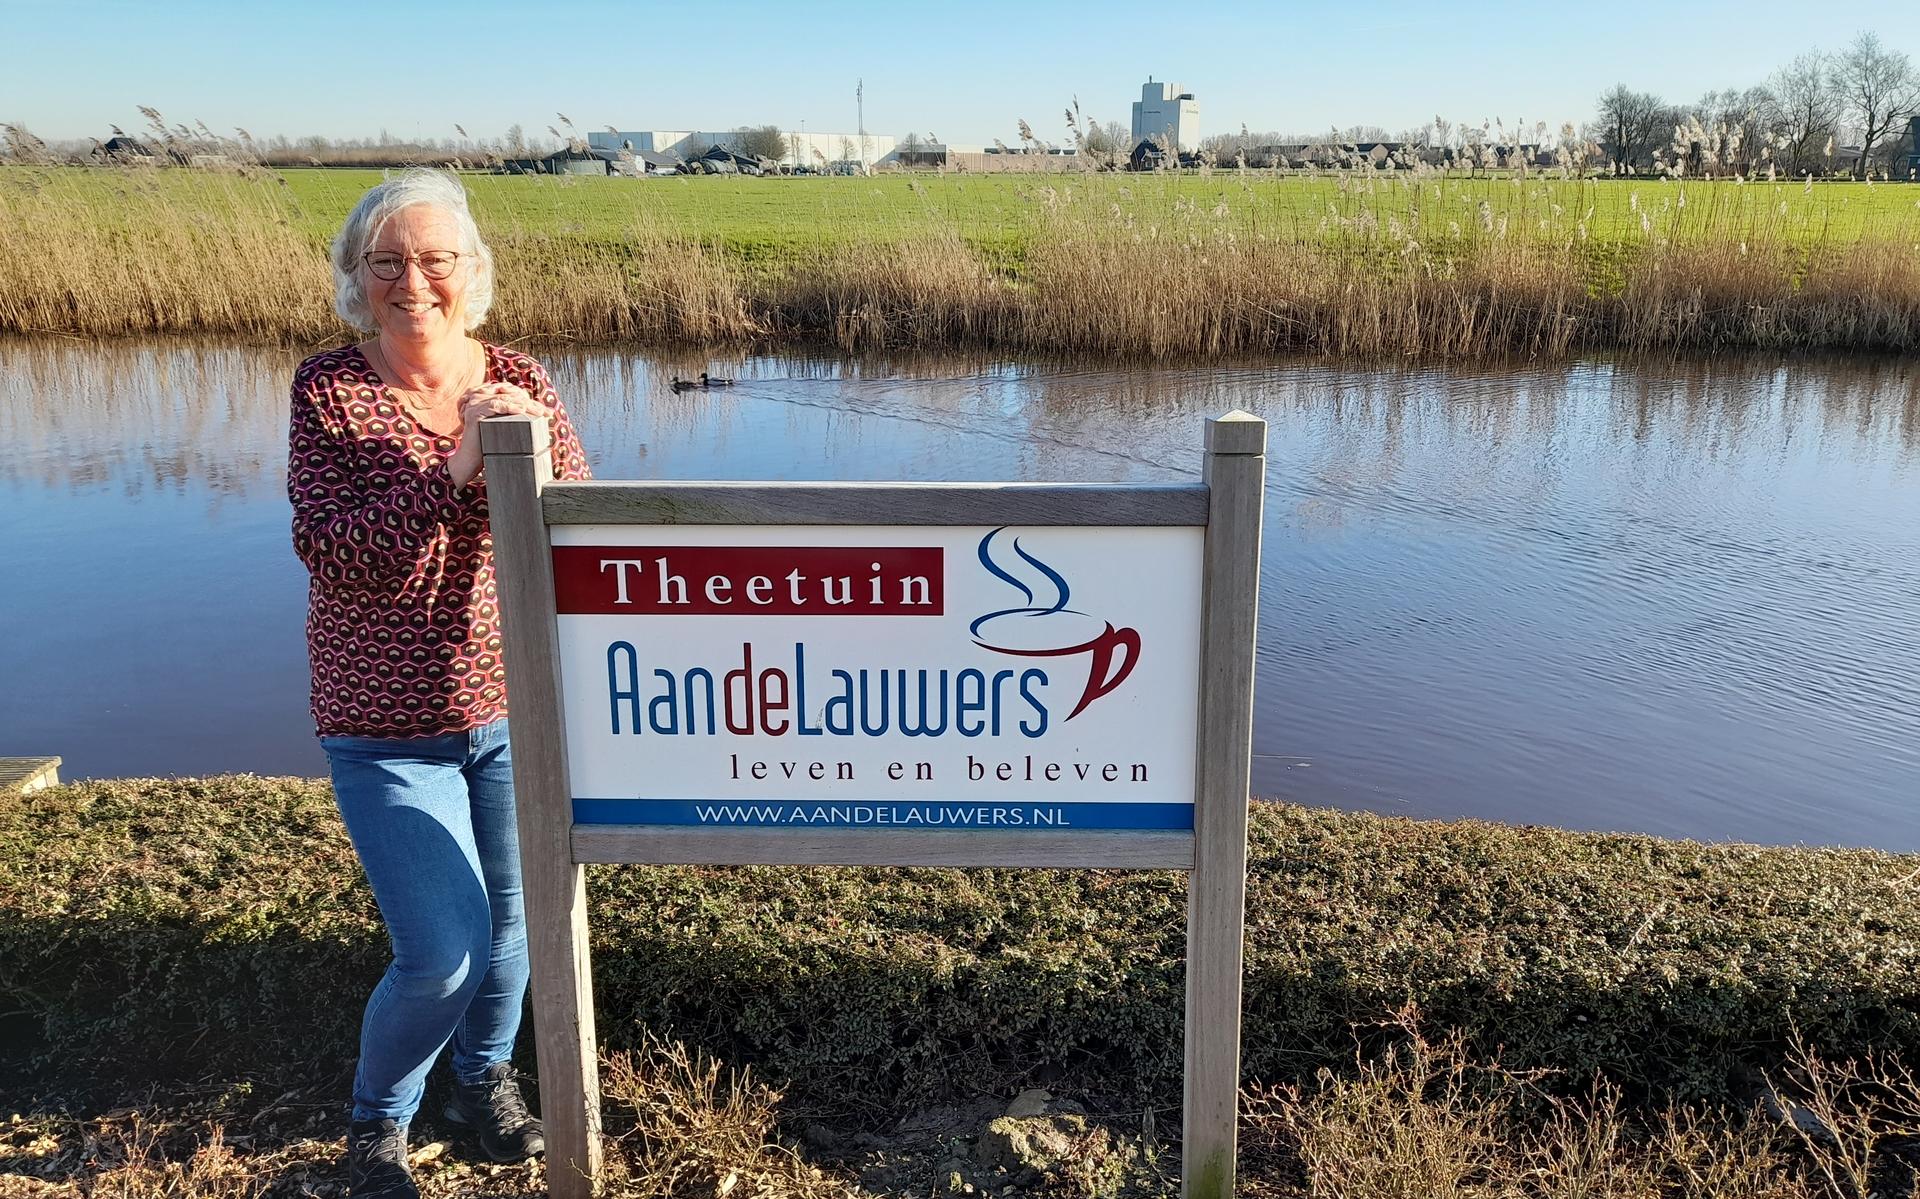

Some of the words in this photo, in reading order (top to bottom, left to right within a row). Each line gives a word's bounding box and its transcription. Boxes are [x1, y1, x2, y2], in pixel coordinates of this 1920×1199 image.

[600, 558, 933, 607] Theetuin
[730, 754, 856, 781] leven
[886, 763, 935, 782] en
[967, 755, 1149, 783] beleven
[695, 804, 1071, 827] WWW.AANDELAUWERS.NL
